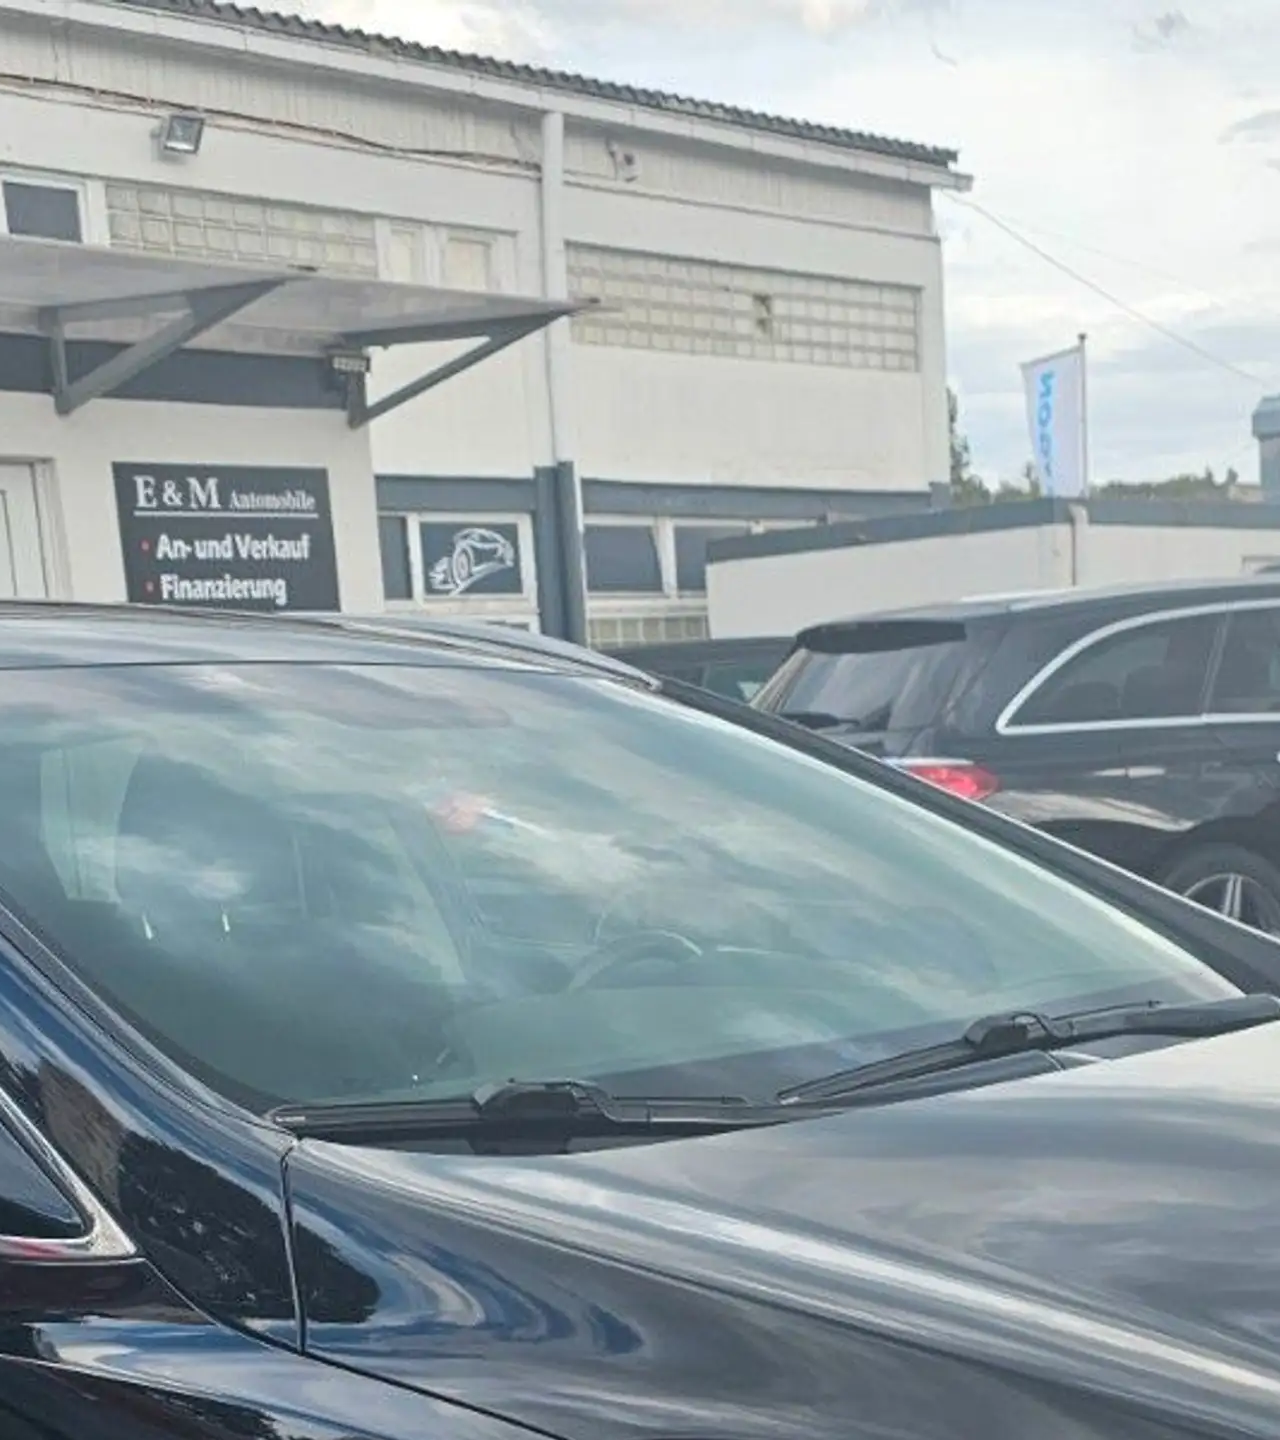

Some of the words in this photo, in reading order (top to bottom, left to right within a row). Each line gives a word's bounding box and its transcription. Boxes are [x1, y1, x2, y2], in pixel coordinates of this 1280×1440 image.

[133, 475, 157, 508] E
[162, 480, 183, 506] &
[186, 477, 222, 509] M
[228, 490, 316, 510] Automobile
[156, 533, 192, 559] An-
[194, 534, 233, 559] und
[234, 533, 311, 559] Verkauf
[160, 573, 288, 606] Finanzierung
